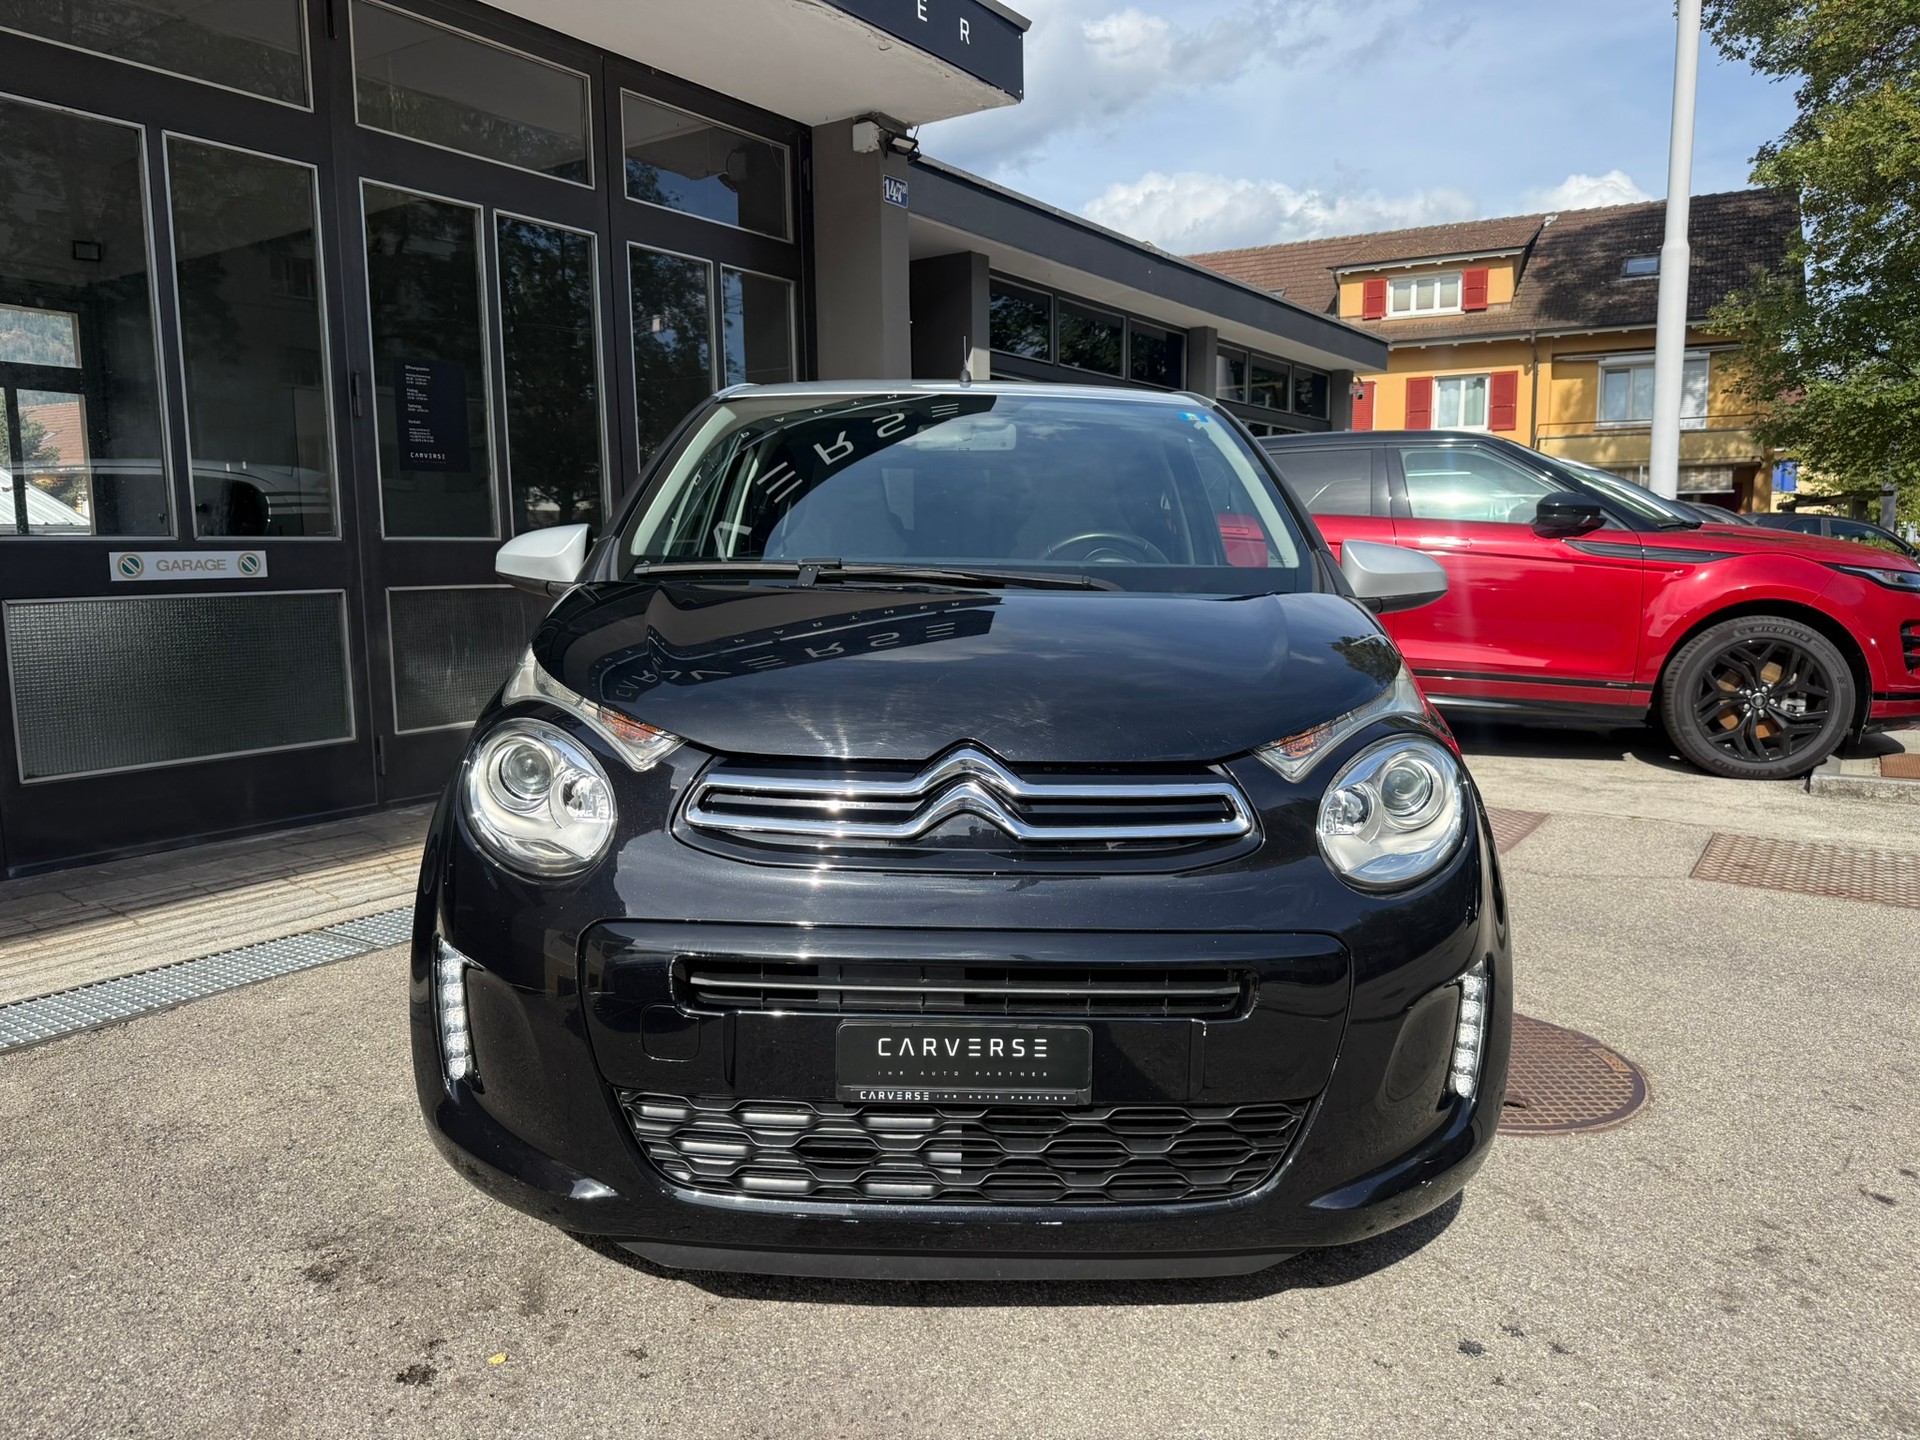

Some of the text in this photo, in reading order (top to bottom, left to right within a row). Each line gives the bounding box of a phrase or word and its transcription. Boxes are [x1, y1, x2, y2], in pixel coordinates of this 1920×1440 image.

[156, 559, 227, 572] GARAGE
[1752, 625, 1810, 642] MICHELIN
[877, 1037, 1048, 1058] CARVERSE
[975, 1070, 1048, 1078] PARTNER
[860, 1090, 930, 1102] CARVERSE
